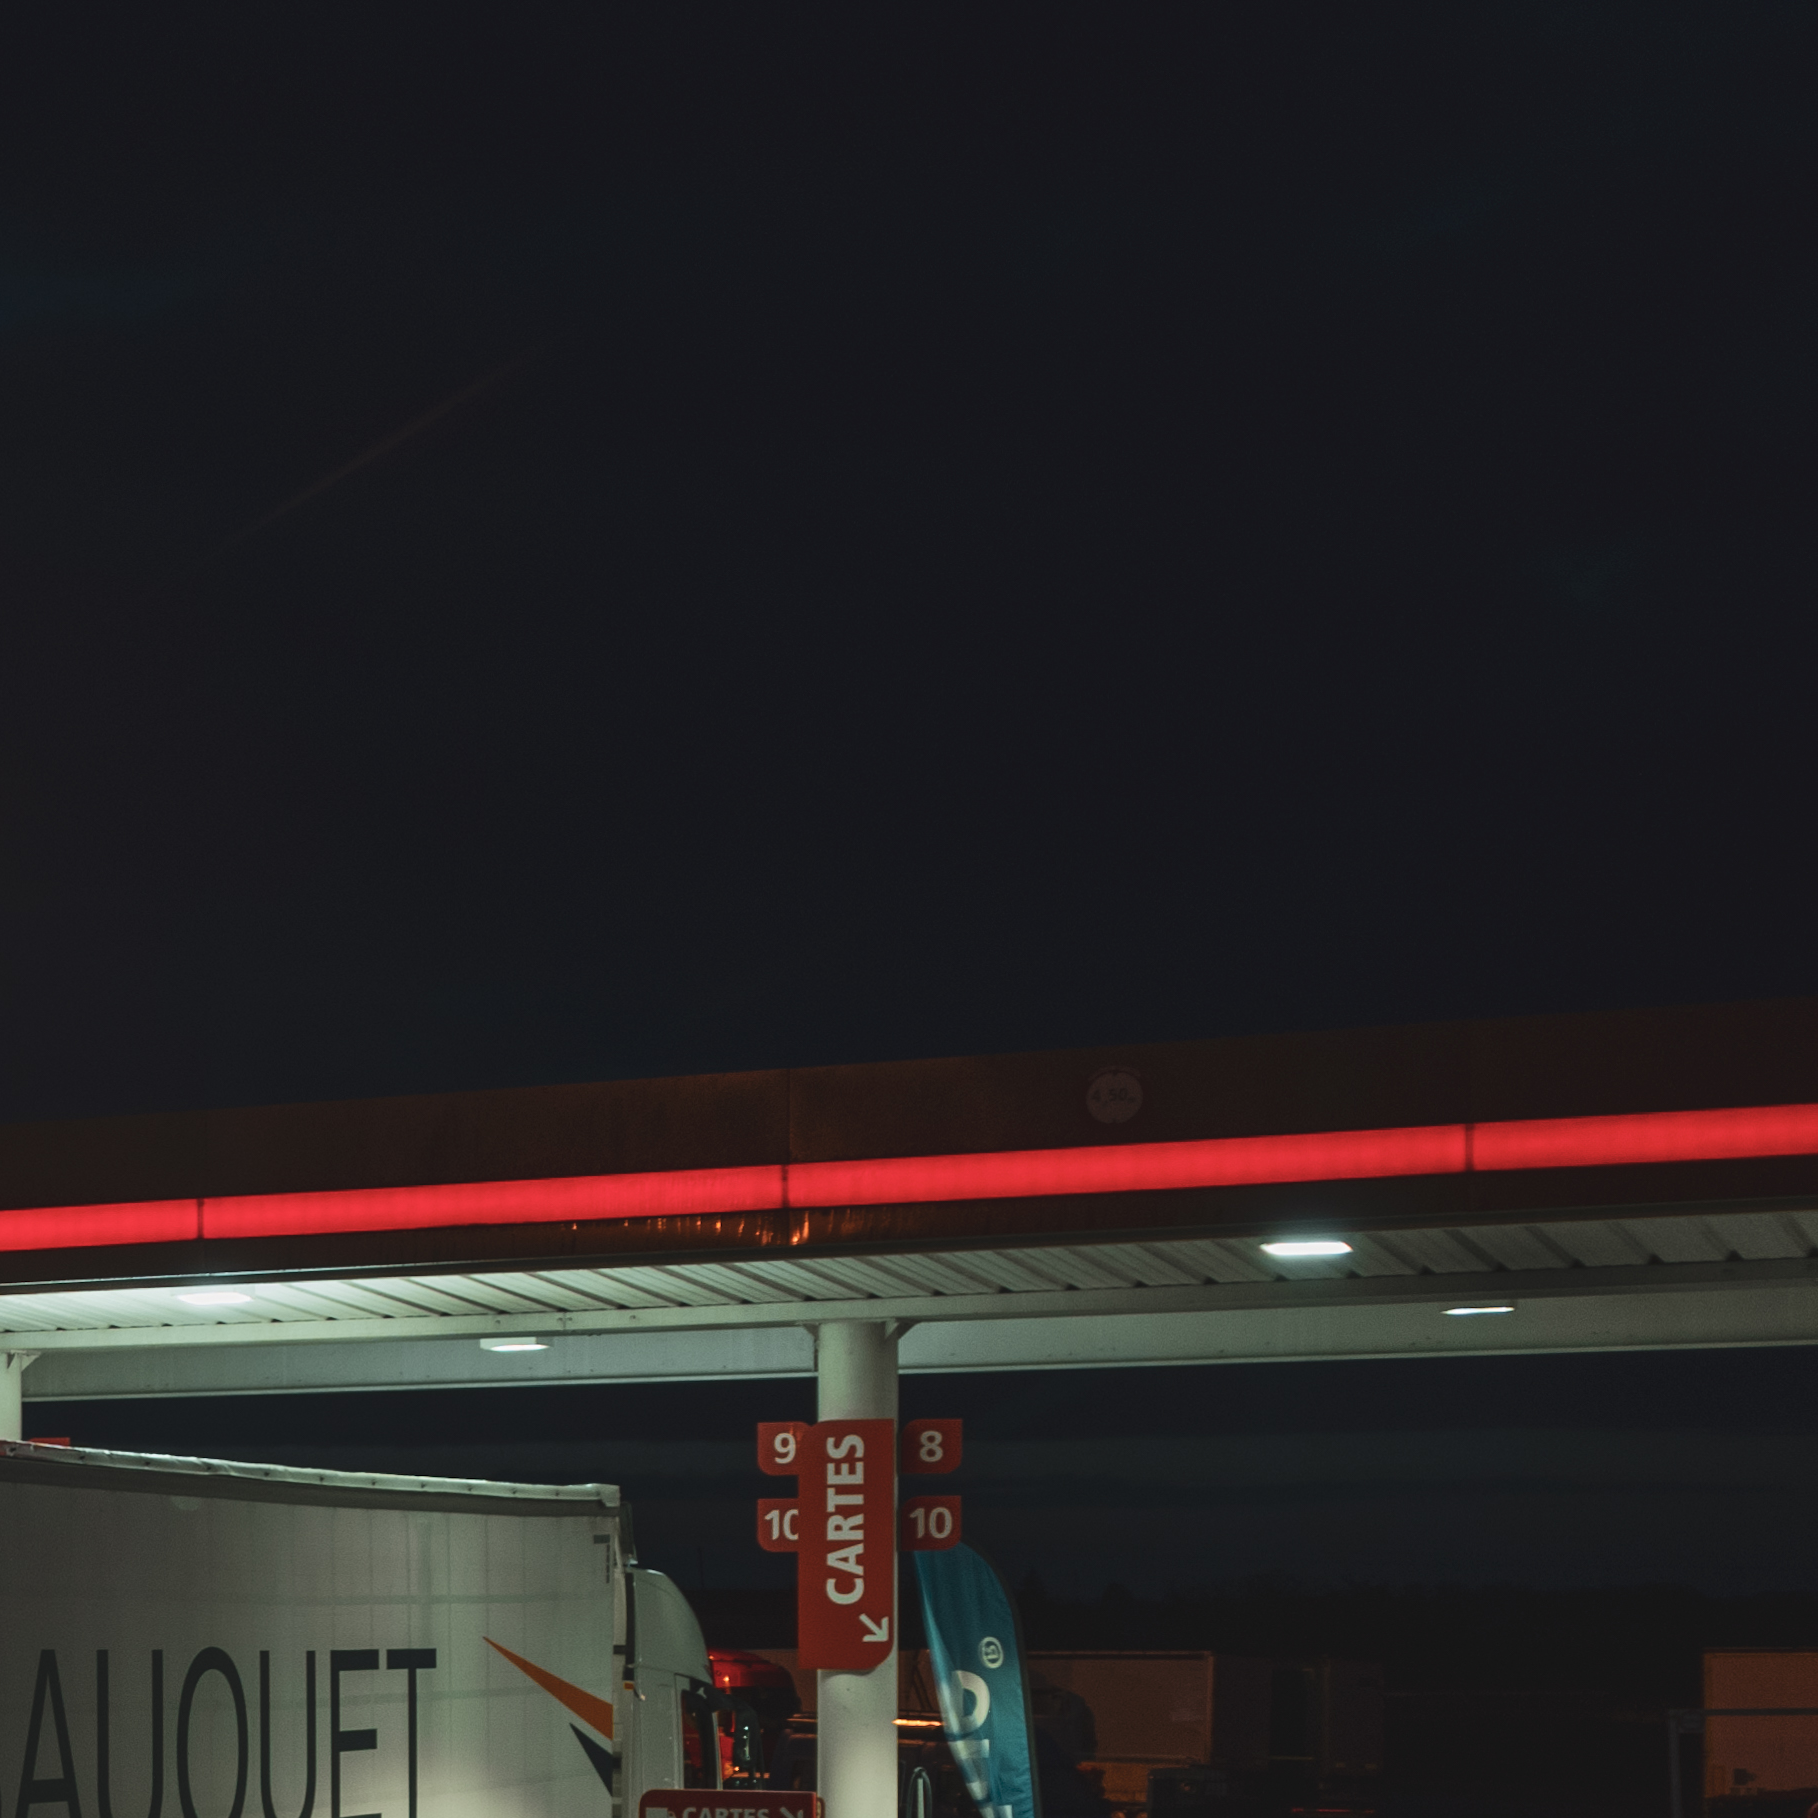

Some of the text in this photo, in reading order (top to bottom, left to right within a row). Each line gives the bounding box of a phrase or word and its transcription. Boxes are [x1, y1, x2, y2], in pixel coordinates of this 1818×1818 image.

[773, 1432, 797, 1464] 9
[919, 1430, 943, 1463] 8
[826, 1433, 865, 1605] CARTES
[909, 1507, 953, 1539] 10
